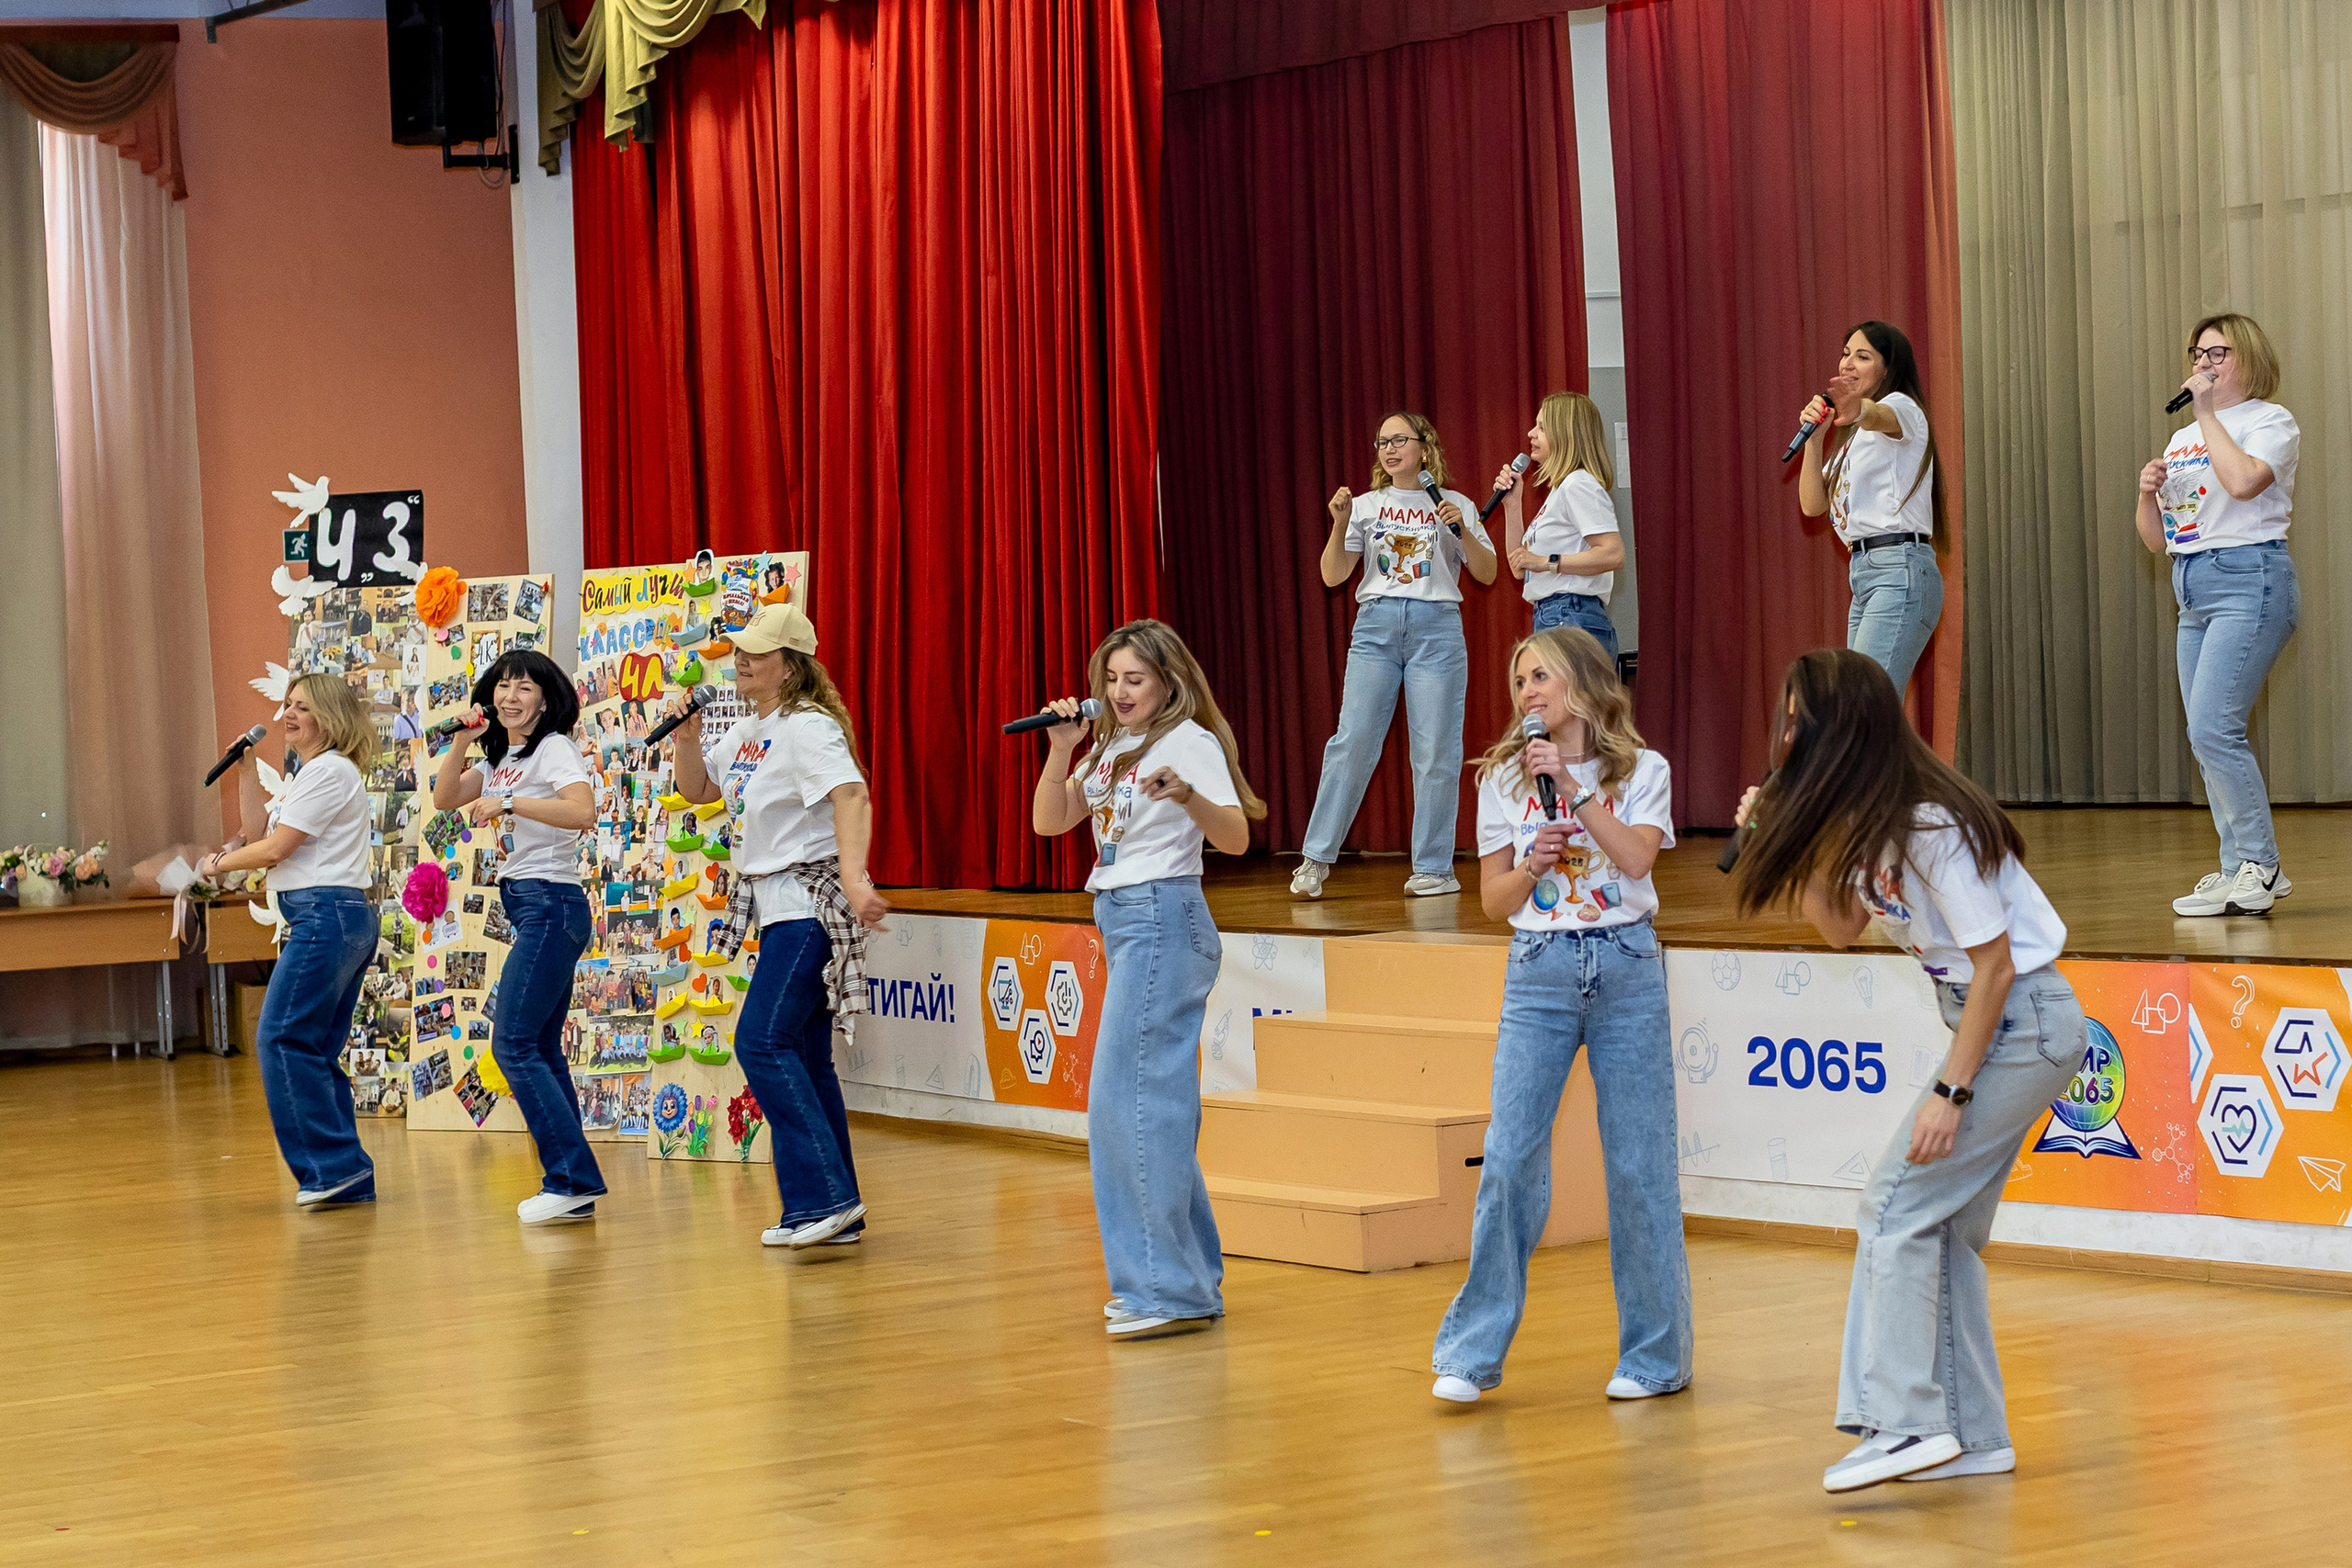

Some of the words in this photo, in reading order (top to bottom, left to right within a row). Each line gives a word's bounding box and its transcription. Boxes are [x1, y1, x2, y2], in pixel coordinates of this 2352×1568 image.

[1378, 506, 1437, 525] МАМА
[582, 577, 632, 613] Самый
[1747, 1036, 1886, 1094] 2065
